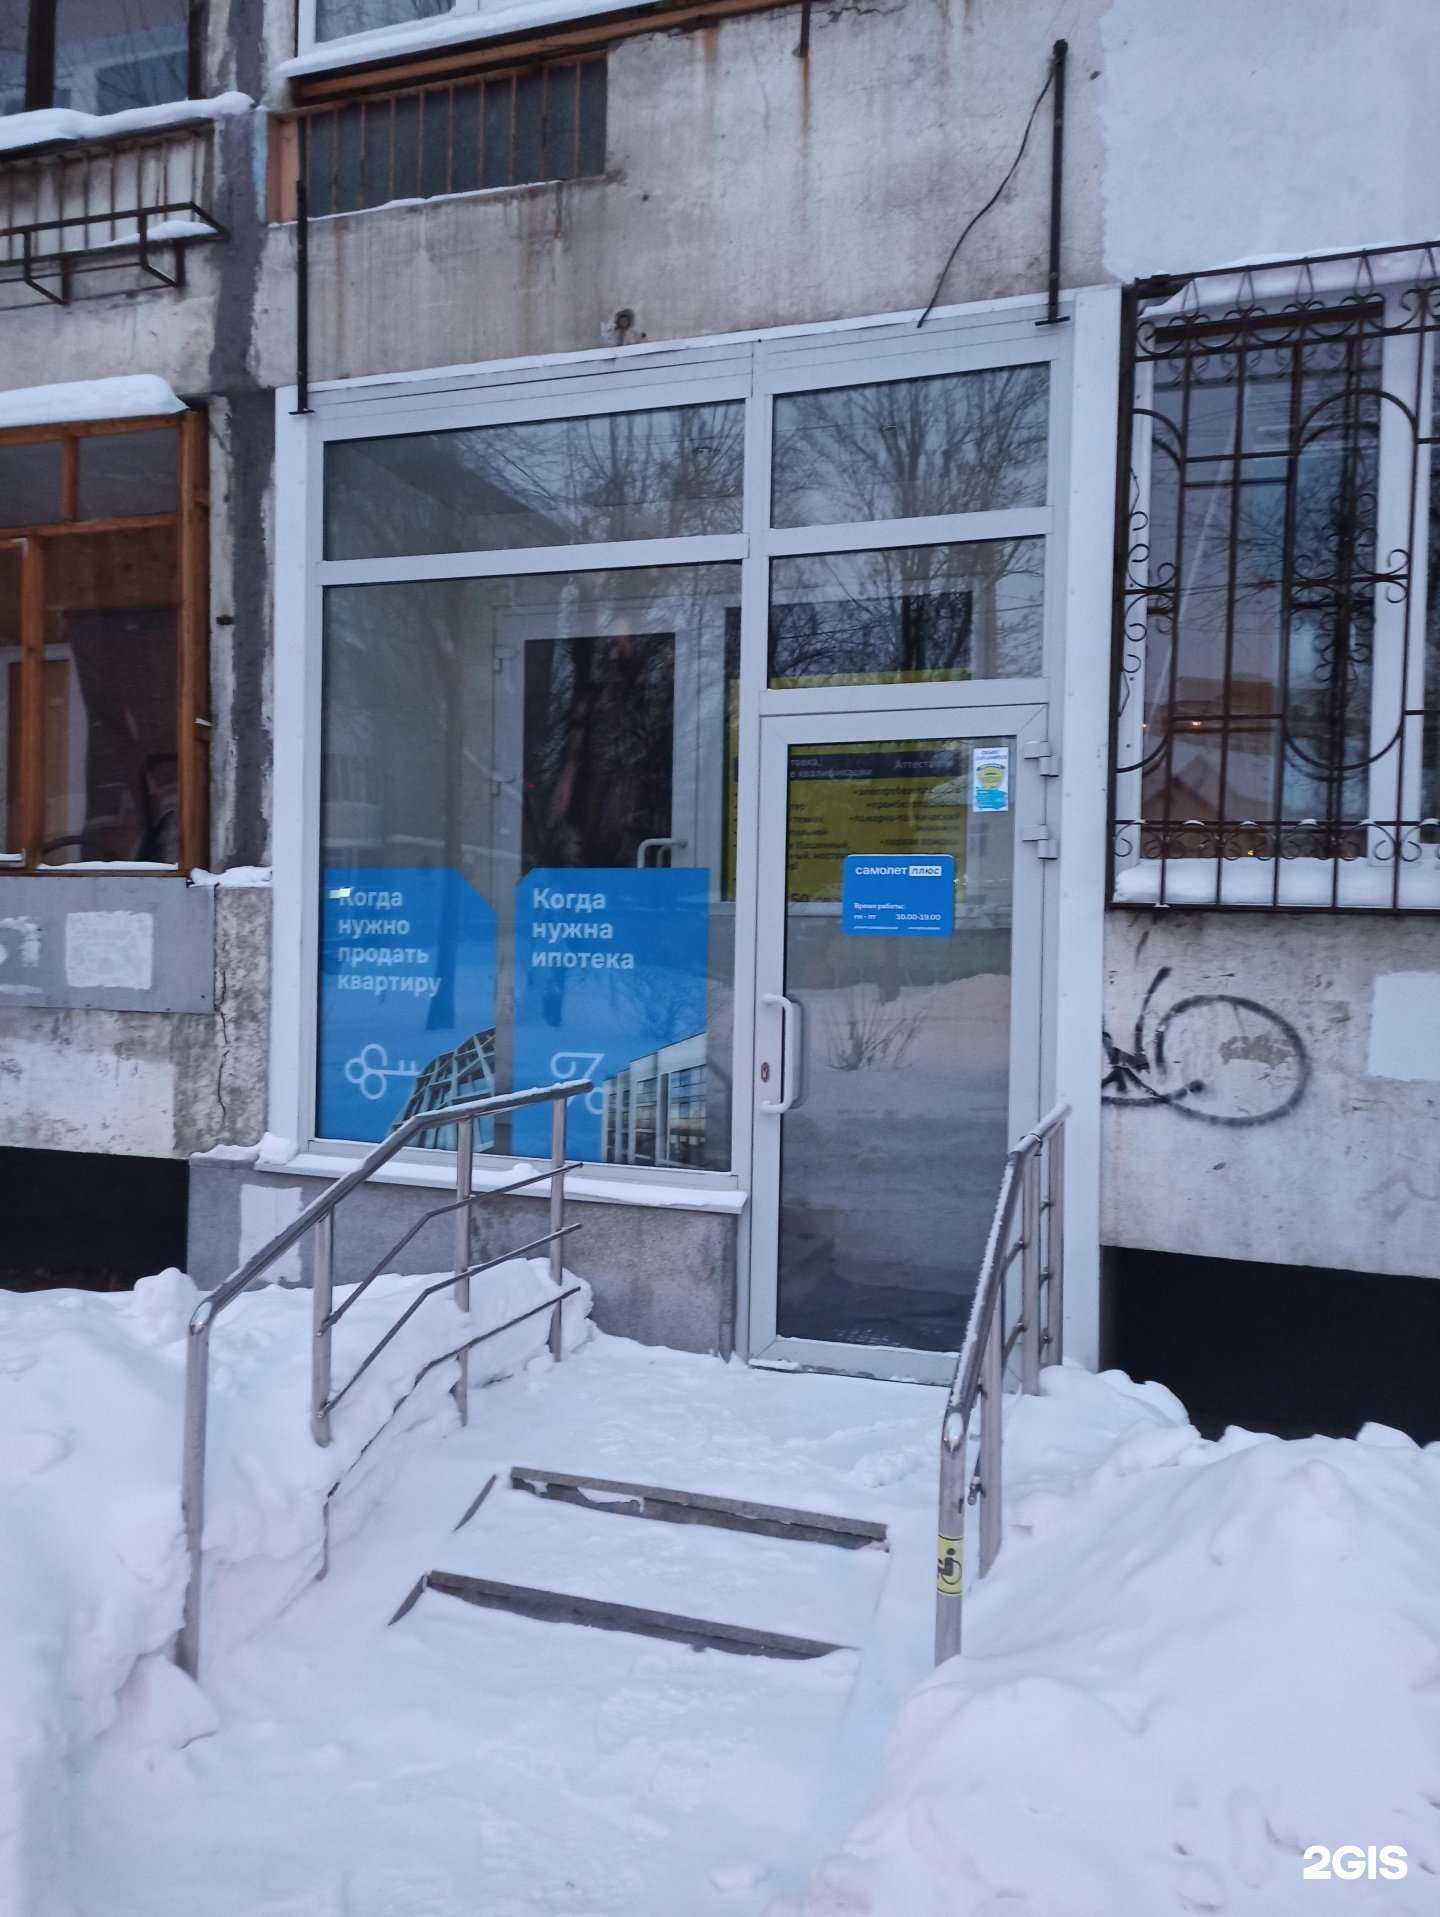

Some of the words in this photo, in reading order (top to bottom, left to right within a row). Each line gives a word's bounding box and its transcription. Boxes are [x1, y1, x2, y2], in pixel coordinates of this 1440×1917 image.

[855, 866, 908, 876] самолет
[533, 887, 607, 913] Когда
[337, 919, 411, 940] нужно
[532, 921, 614, 944] нужна
[337, 947, 430, 968] продать
[531, 951, 635, 970] ипотека
[337, 974, 442, 998] квартиру
